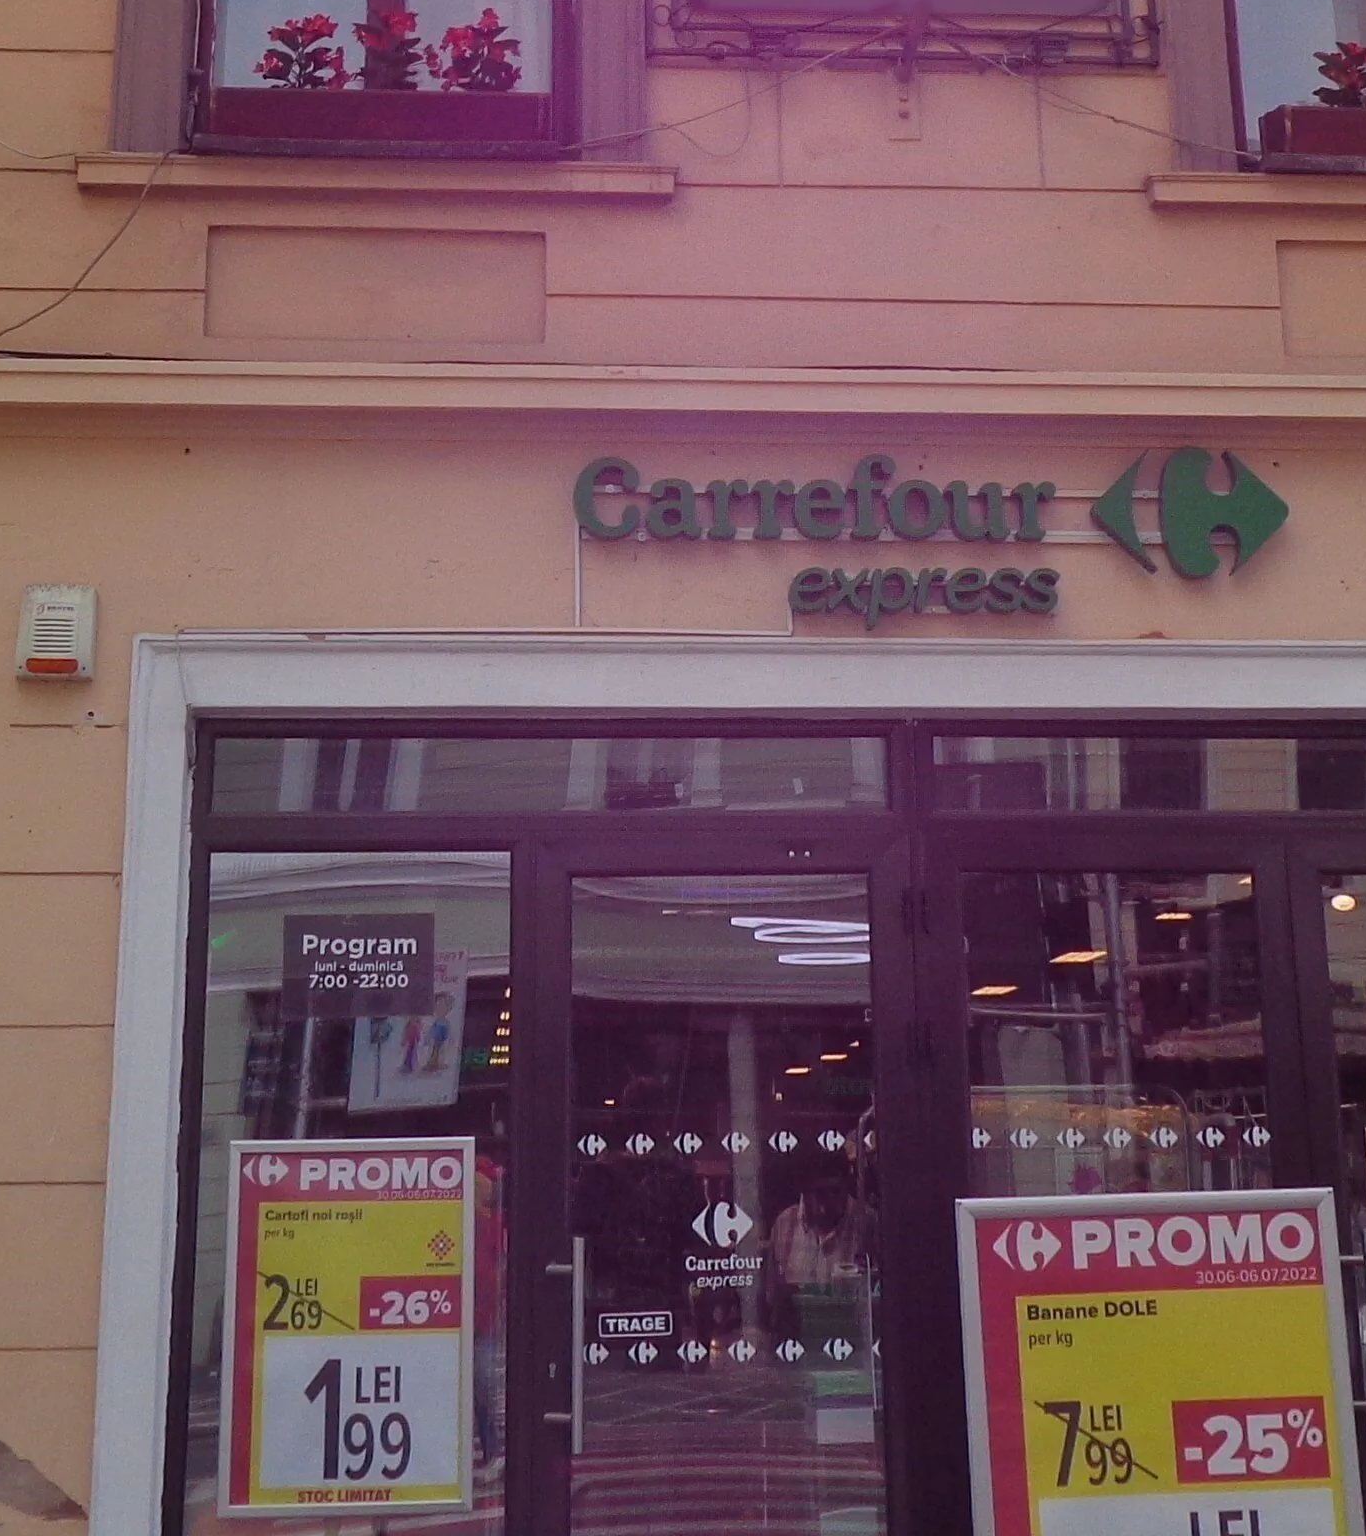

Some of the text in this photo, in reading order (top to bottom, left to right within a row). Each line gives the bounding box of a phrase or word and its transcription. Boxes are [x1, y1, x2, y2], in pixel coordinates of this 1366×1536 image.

[573, 454, 1057, 543] Carrefour
[787, 564, 1061, 632] express
[302, 934, 417, 959] Program
[315, 960, 337, 972] luni
[349, 960, 404, 972] duminică
[309, 974, 348, 989] 7:00
[299, 1155, 463, 1192] PROMO
[265, 1209, 309, 1221] Cartofi
[312, 1208, 332, 1221] noi
[264, 1227, 295, 1241] per kg
[1070, 1212, 1316, 1270] PROMO
[685, 1254, 763, 1272] Carrefour
[1195, 1267, 1318, 1285] 30.06-06.07.2022
[296, 1278, 318, 1297] LEI
[696, 1273, 753, 1291] express
[263, 1274, 290, 1331] 2
[291, 1300, 323, 1330] 69
[369, 1289, 452, 1325] -26%
[1026, 1299, 1159, 1322] Banane DOLE
[605, 1316, 666, 1333] TRAGE
[1028, 1330, 1073, 1350] per kg
[355, 1366, 402, 1404] LEI
[303, 1358, 342, 1481] 1
[1089, 1404, 1123, 1432] LEI
[342, 1412, 412, 1481] 99
[1043, 1400, 1082, 1488] 7
[1184, 1407, 1325, 1476] -25%
[1085, 1437, 1134, 1486] 99
[297, 1489, 393, 1504] STOC LIMITAT
